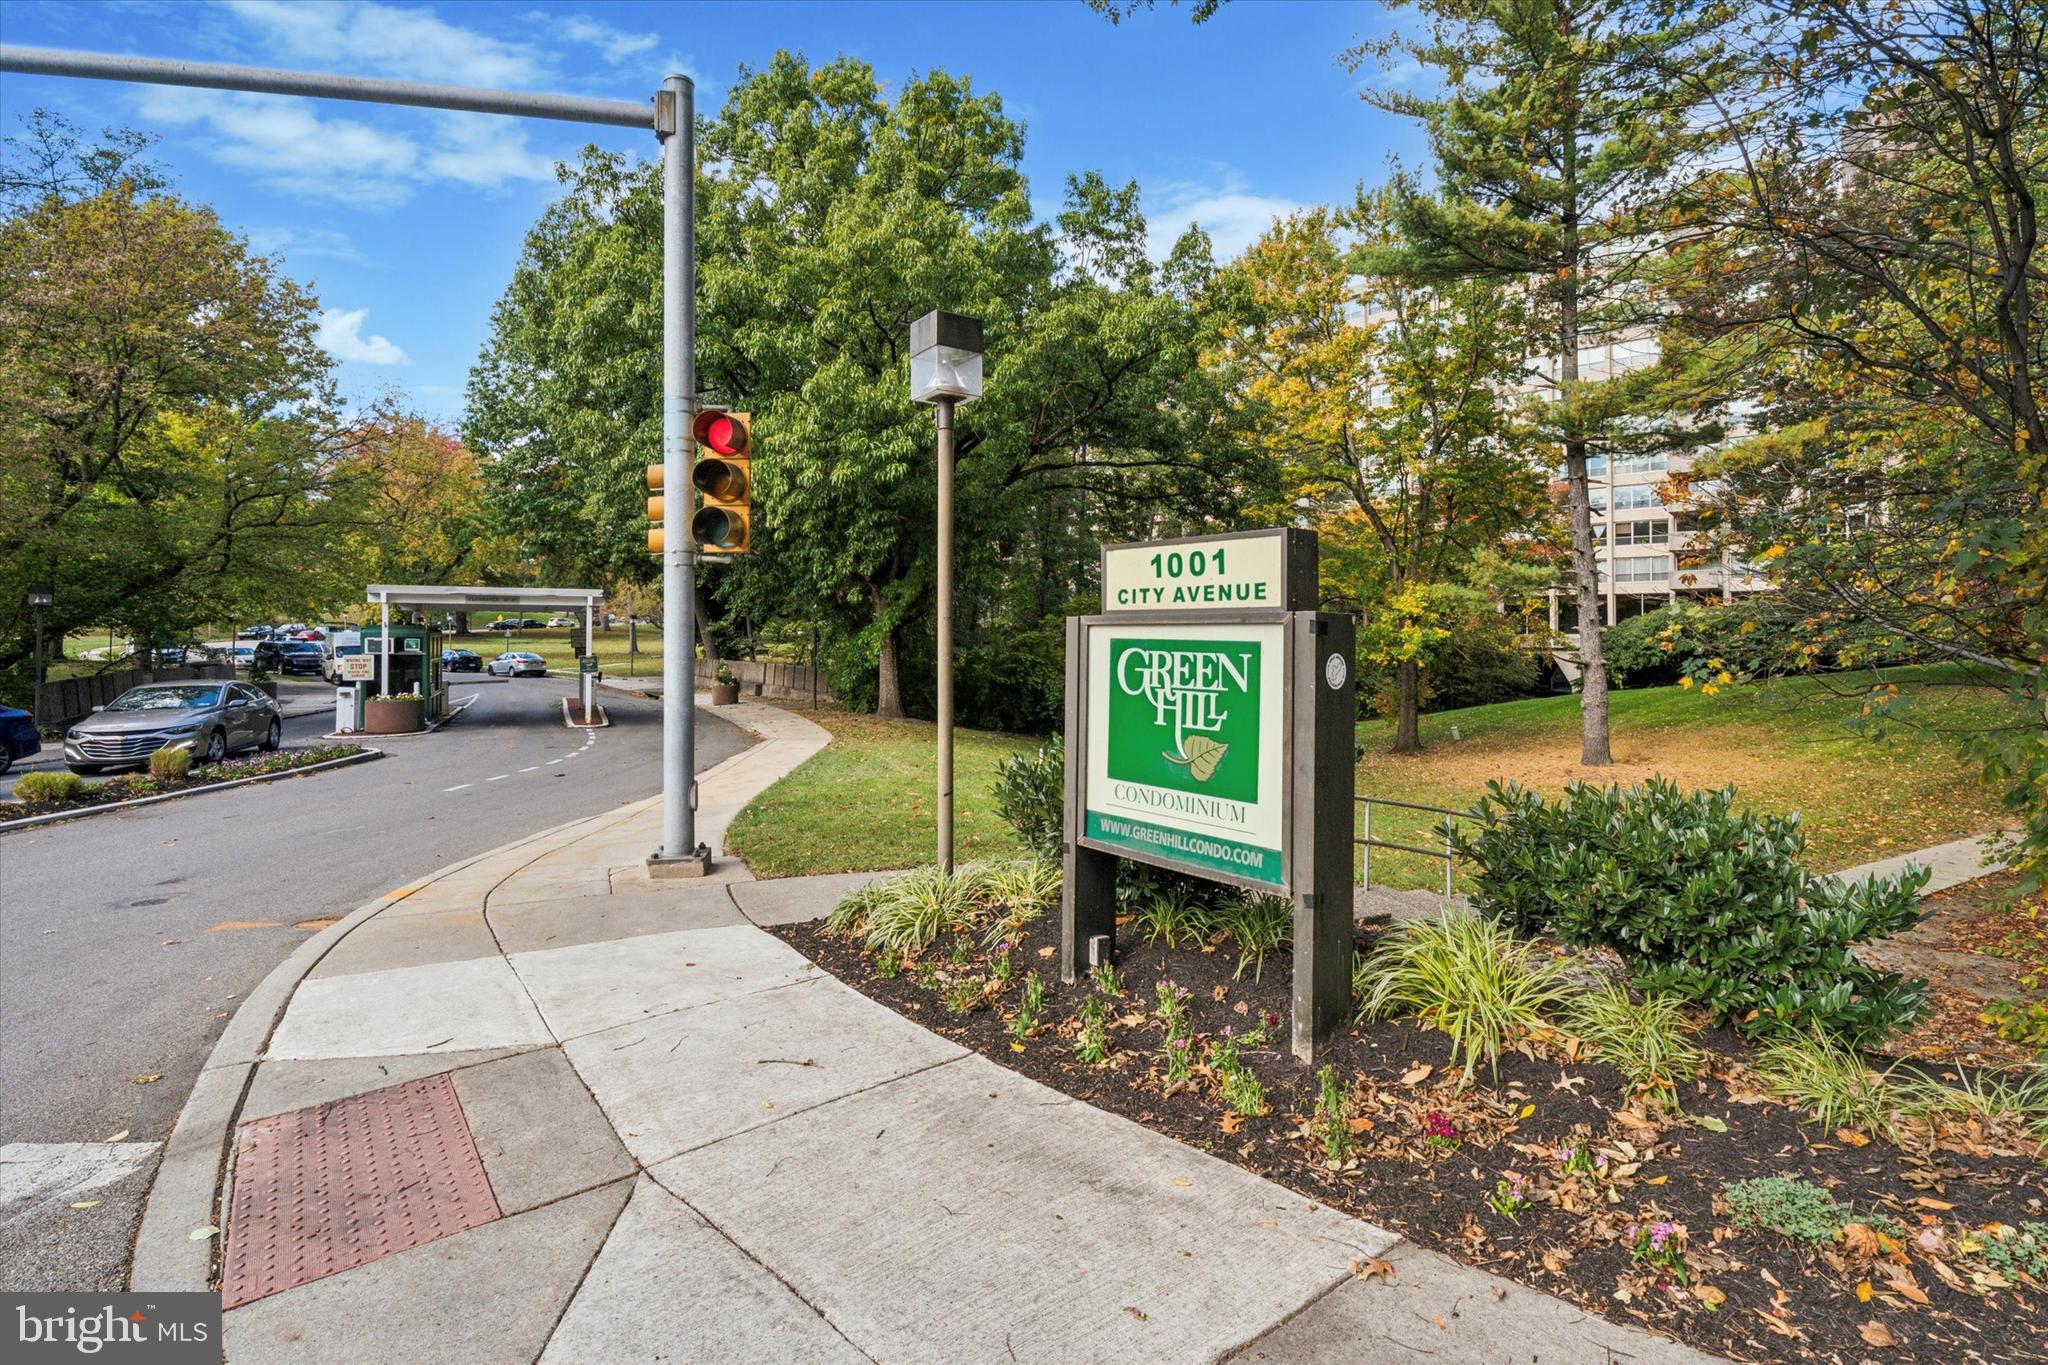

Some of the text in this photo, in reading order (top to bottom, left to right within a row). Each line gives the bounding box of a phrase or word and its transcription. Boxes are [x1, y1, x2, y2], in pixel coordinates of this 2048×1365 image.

[1150, 548, 1225, 578] 1001
[1118, 582, 1267, 604] CITY AVENUE
[1117, 647, 1252, 700] GREEN
[1153, 688, 1228, 757] HILL
[1114, 783, 1246, 824] CONDOMINIUM
[1100, 818, 1264, 868] WWW.GREENHILLCONDO.COM
